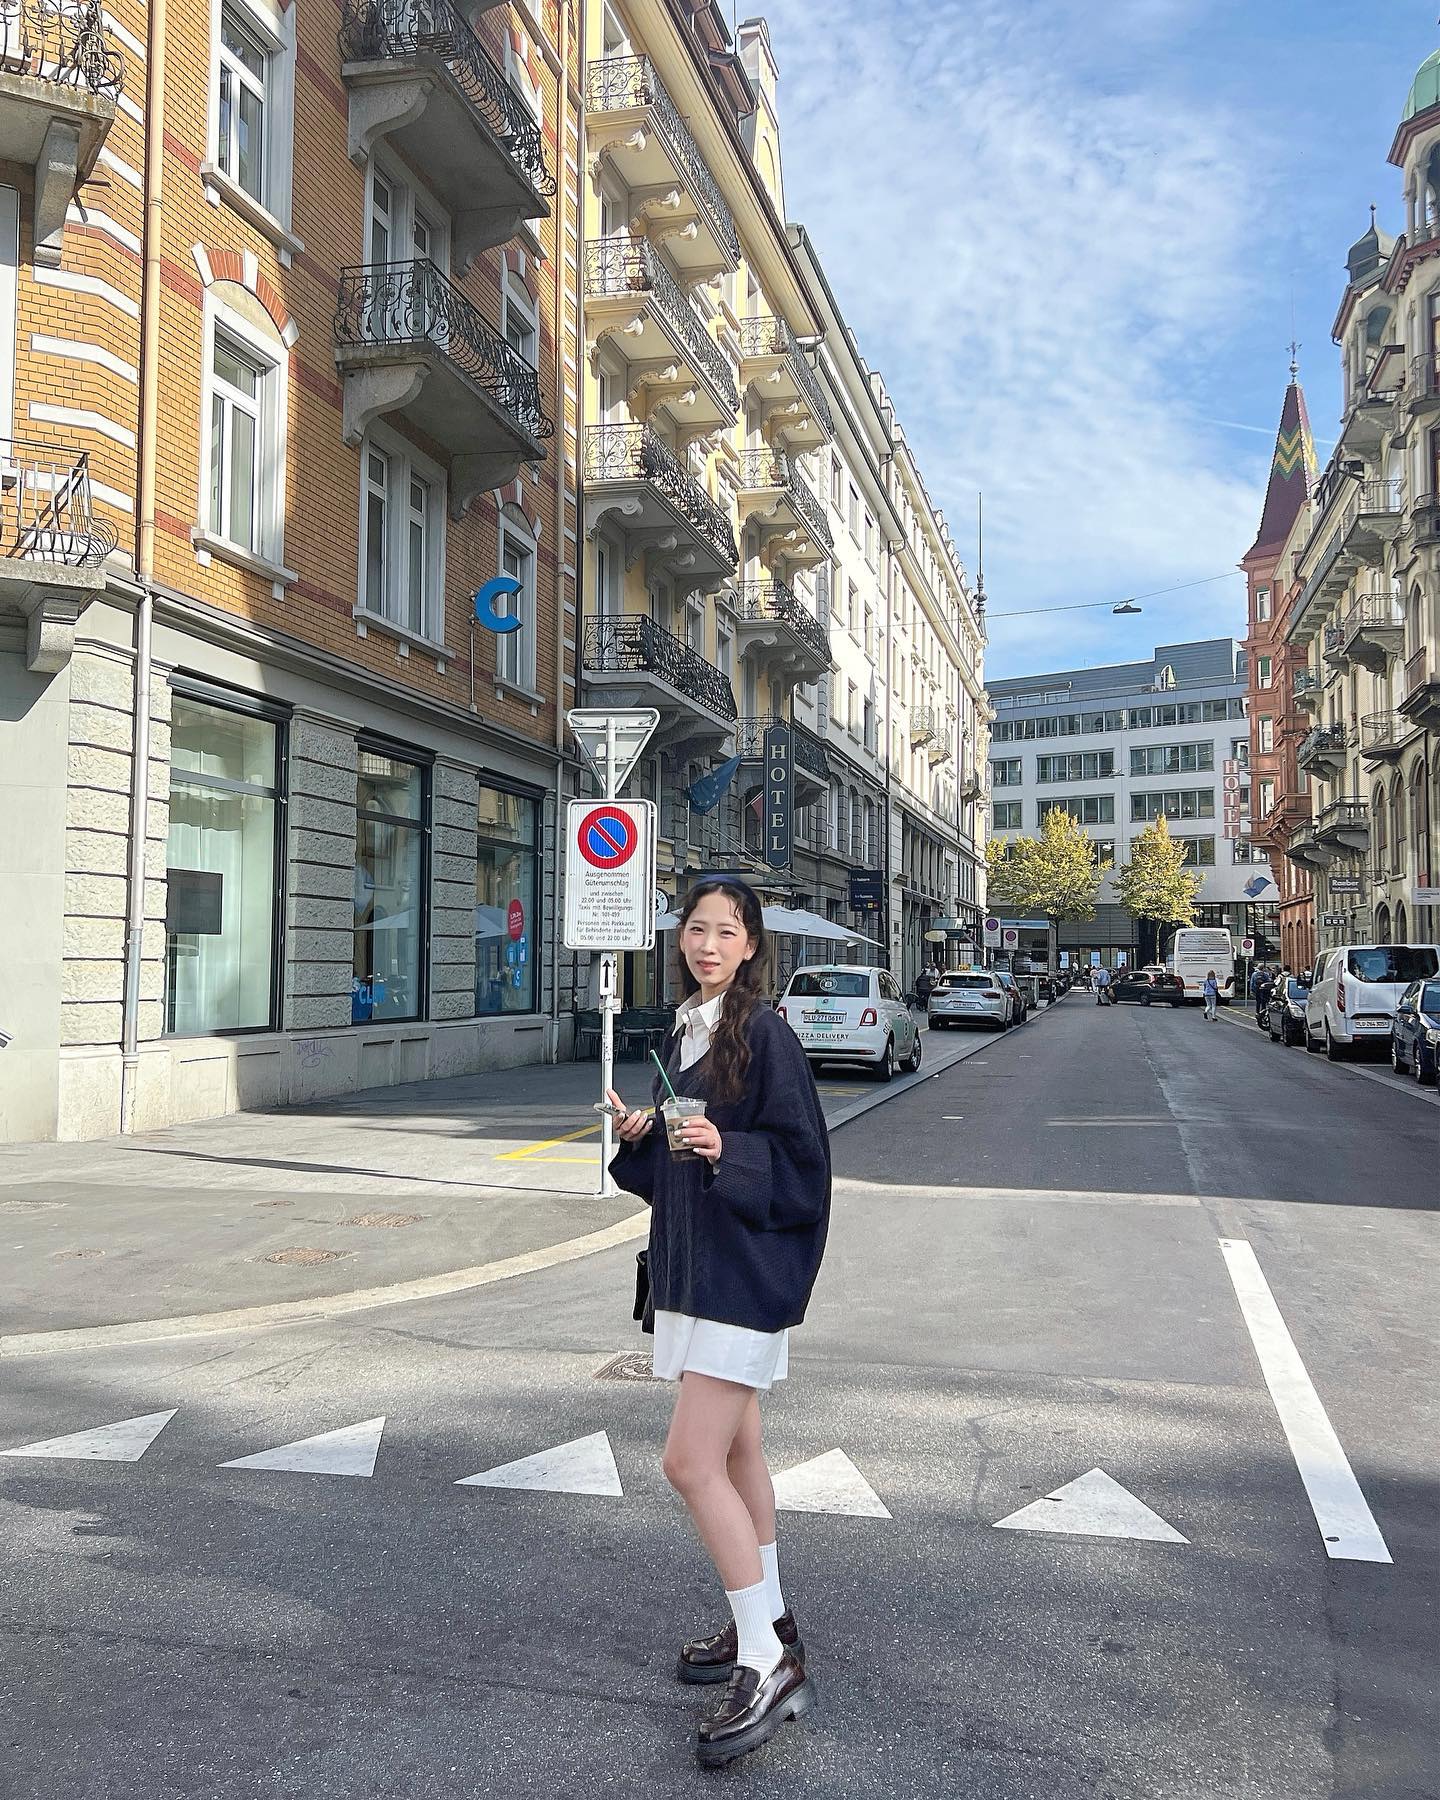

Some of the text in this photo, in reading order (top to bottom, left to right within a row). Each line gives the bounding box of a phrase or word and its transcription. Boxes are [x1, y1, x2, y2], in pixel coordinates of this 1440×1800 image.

[475, 576, 524, 634] C
[770, 744, 787, 851] HOTEL
[1225, 760, 1239, 839] HOTEL
[585, 871, 629, 879] Ausgenommen
[585, 879, 629, 888] Güterumschlag
